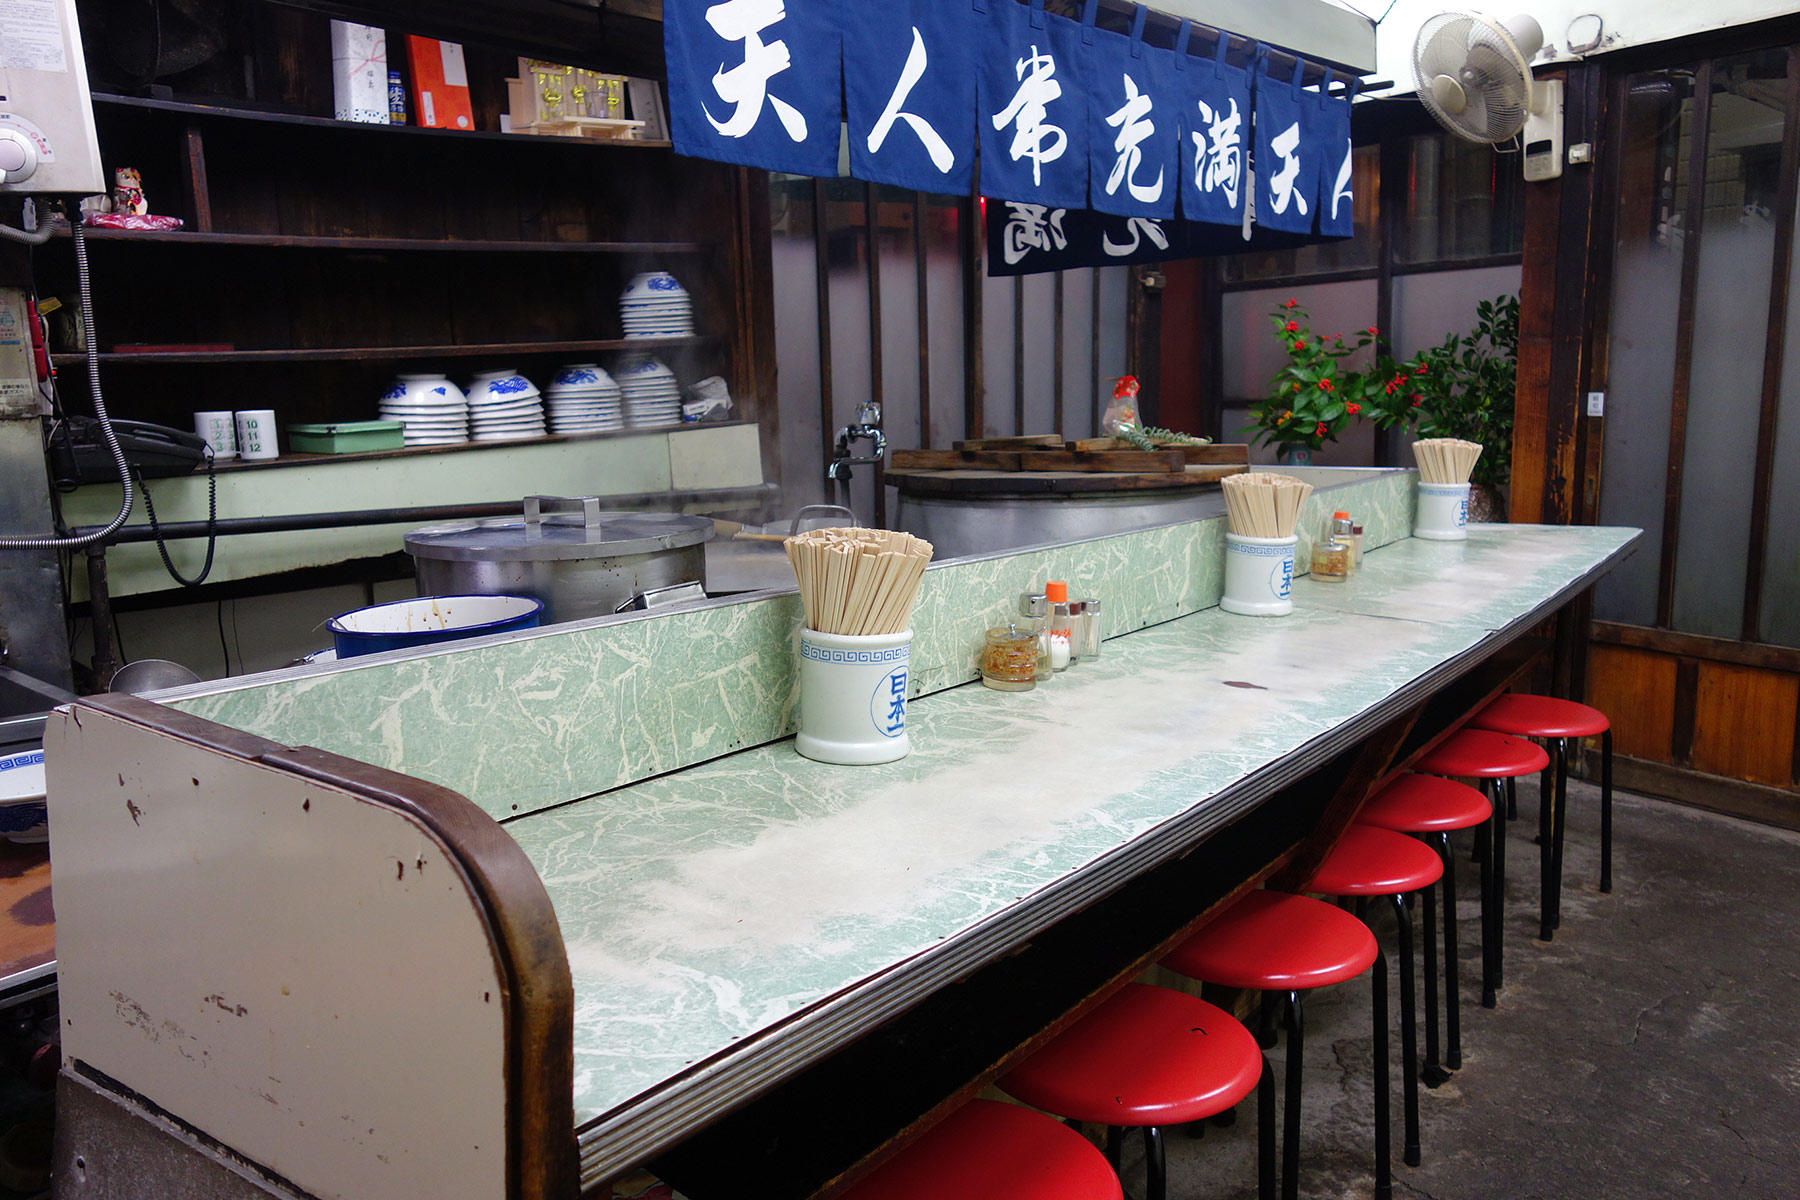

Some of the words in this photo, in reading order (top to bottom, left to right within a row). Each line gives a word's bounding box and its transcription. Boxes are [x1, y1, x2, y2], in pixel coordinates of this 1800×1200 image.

[247, 420, 258, 429] 10
[248, 432, 258, 441] 11
[250, 443, 261, 452] 12
[1280, 560, 1293, 596] 日本一
[887, 672, 907, 733] 日本一
